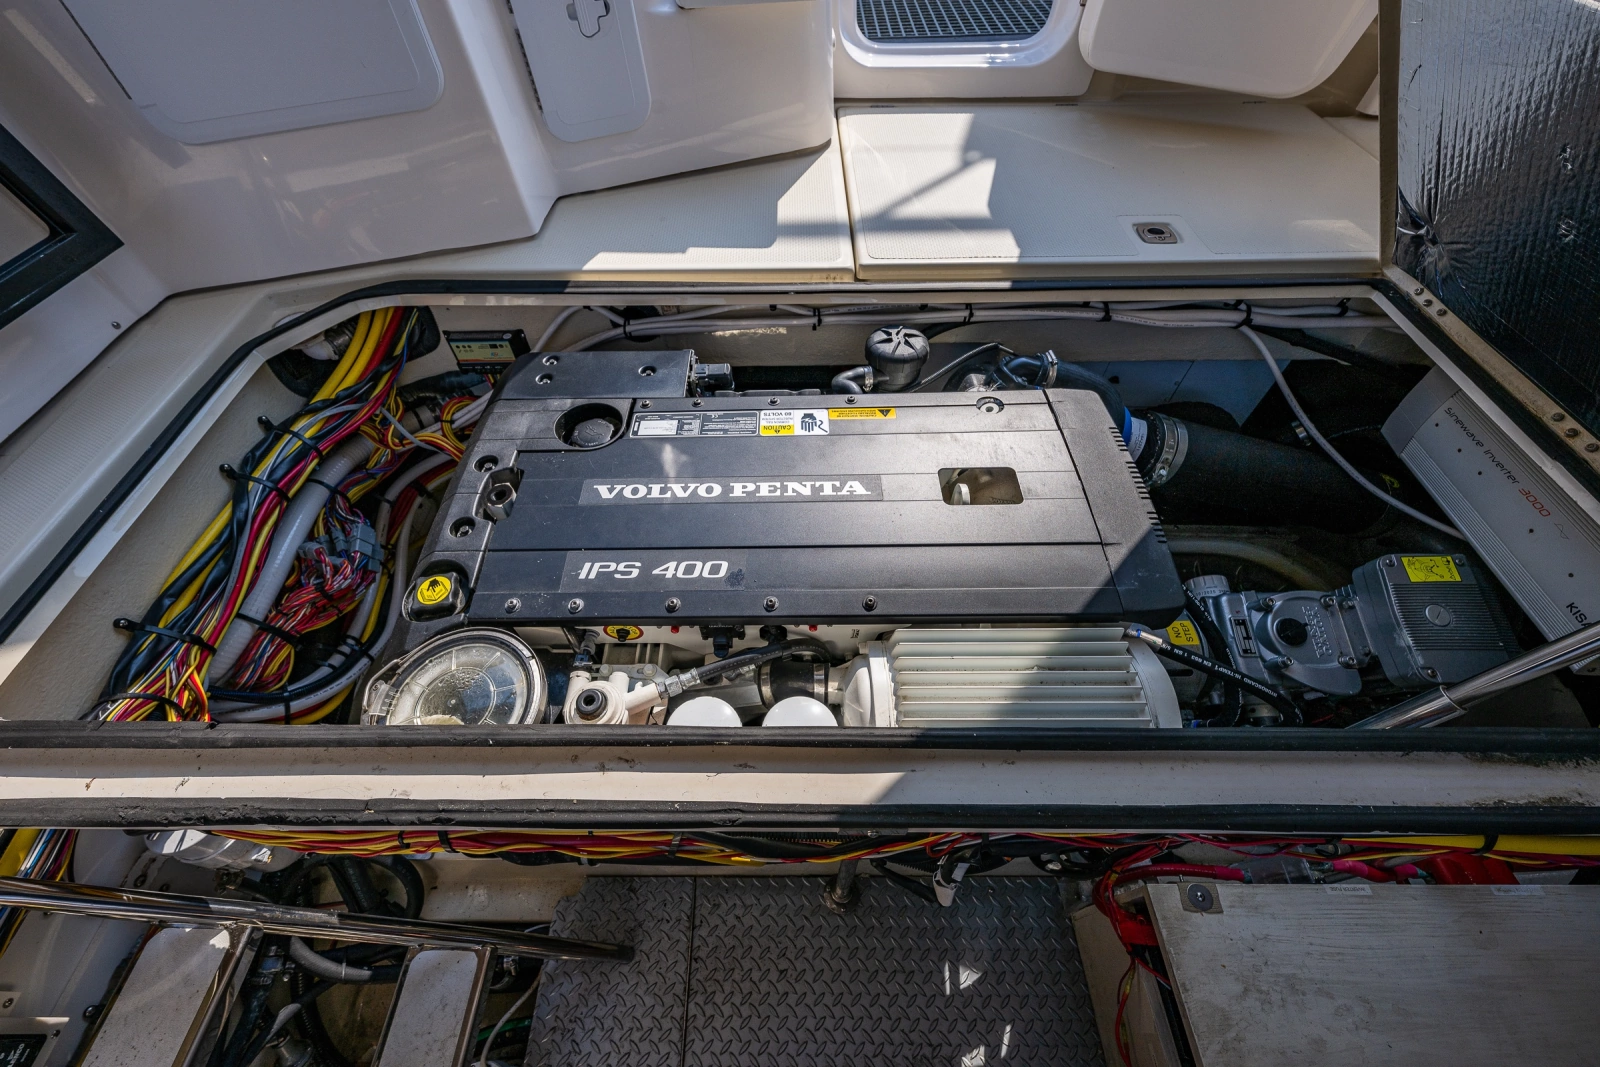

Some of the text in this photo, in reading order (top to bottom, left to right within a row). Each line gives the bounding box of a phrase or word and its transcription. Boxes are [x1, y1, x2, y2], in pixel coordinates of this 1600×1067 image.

[1444, 407, 1551, 518] Sinewave Inverter 3000
[593, 480, 872, 499] VOLVO PENTA
[578, 560, 729, 580] IPS 400
[1171, 626, 1182, 639] NO
[1179, 622, 1194, 642] STEP
[1173, 648, 1183, 656] SN
[1203, 659, 1212, 667] EN
[1243, 677, 1278, 698] HYDROSCAND
